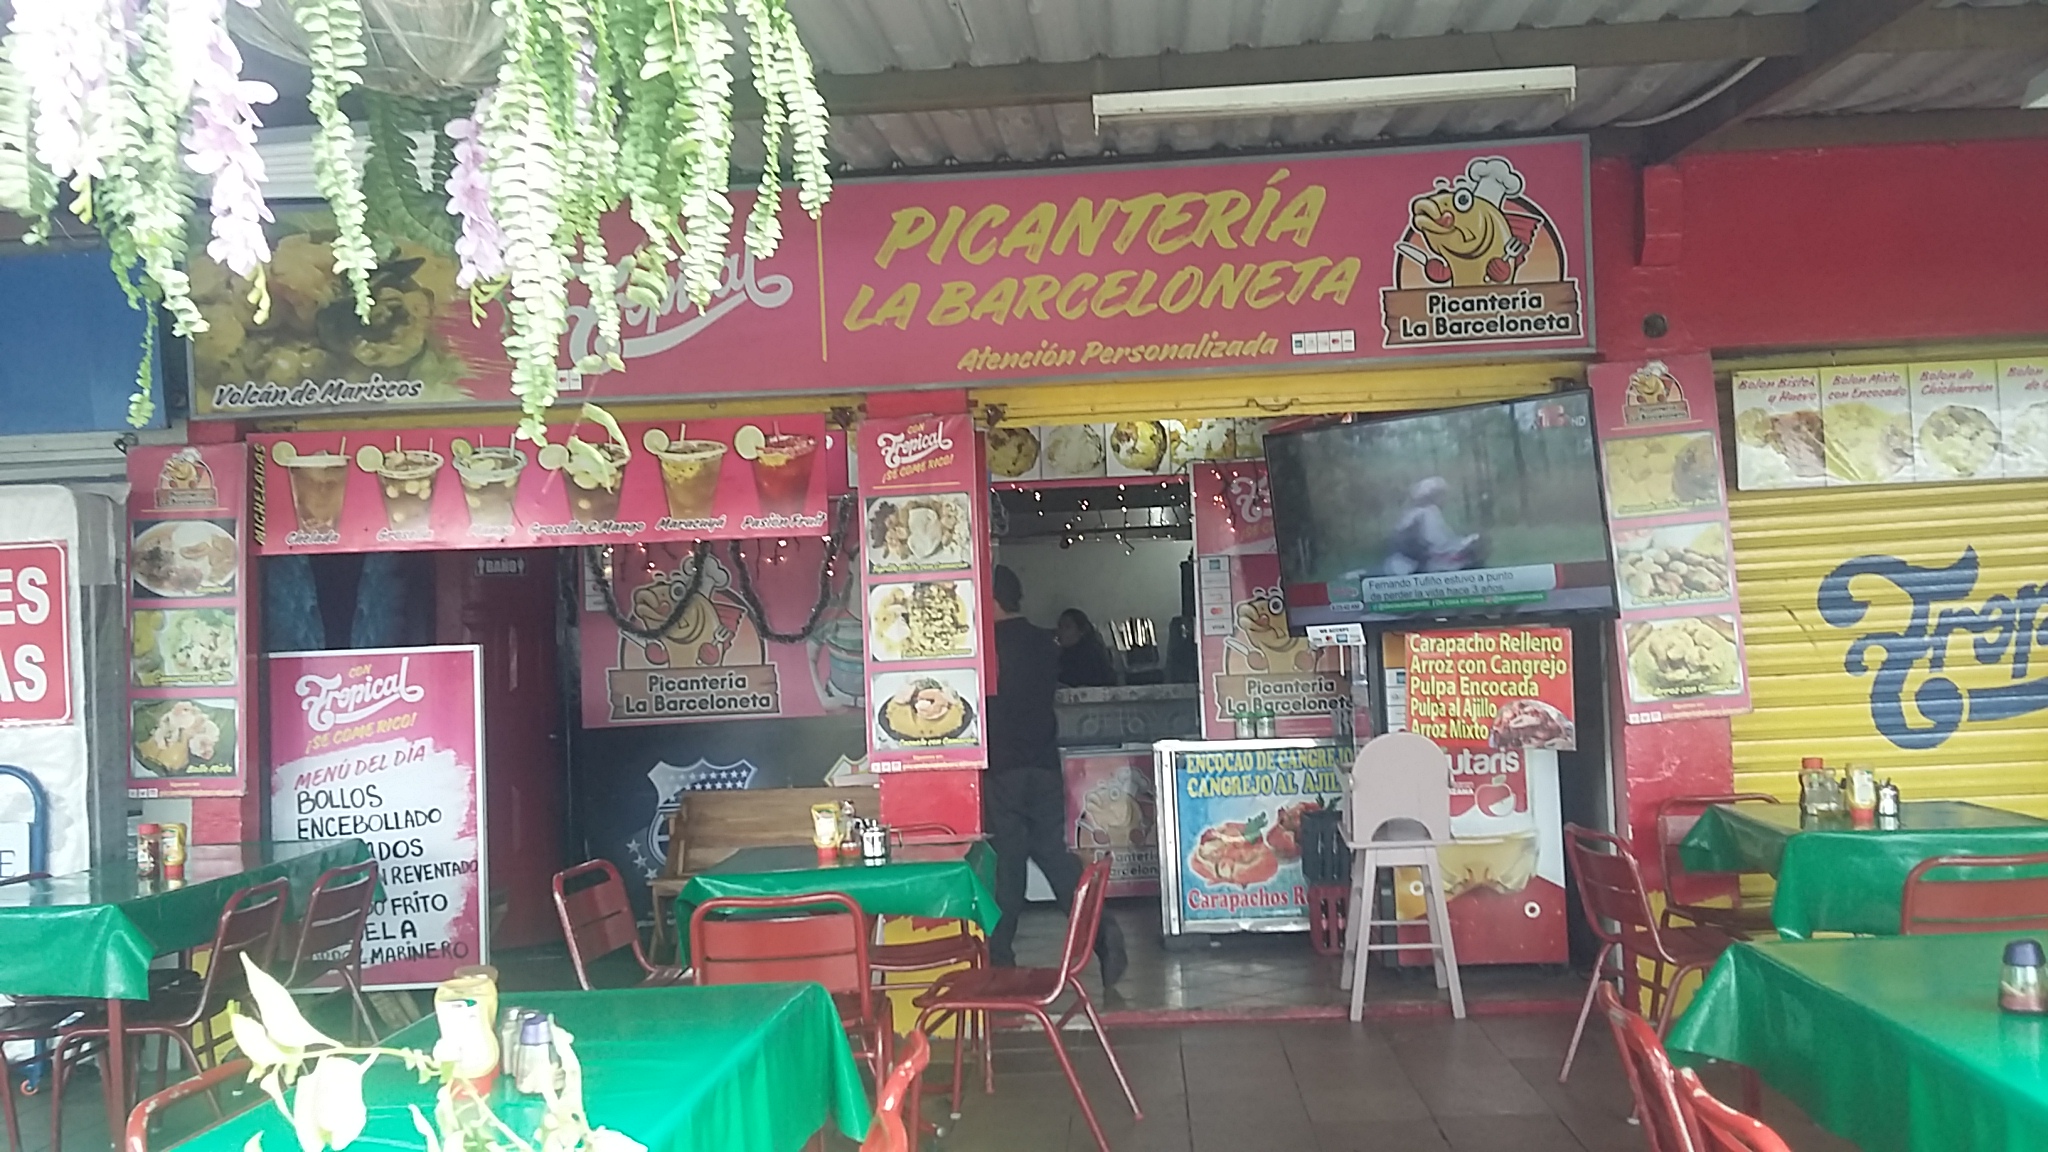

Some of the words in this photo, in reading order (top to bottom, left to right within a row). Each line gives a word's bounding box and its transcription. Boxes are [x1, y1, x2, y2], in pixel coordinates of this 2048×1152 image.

[874, 168, 1326, 269] PICANTERÍA
[843, 282, 921, 331] LA
[927, 256, 1361, 326] BARCELONETA
[1429, 291, 1542, 313] Picantería
[1402, 318, 1427, 337] La
[1435, 315, 1570, 335] Barceloneta
[957, 339, 1076, 373] Atención
[1080, 331, 1279, 365] Personalizada
[214, 382, 287, 406] Volcán
[291, 380, 319, 405] de
[321, 374, 423, 403] Mariscos
[877, 420, 954, 469] Tropical
[254, 443, 266, 546] MICHELADAS
[789, 510, 828, 529] Fruit
[1369, 579, 1411, 590] Fernando
[1445, 575, 1475, 585] estuvo
[1486, 571, 1514, 582] punto
[1426, 586, 1445, 597] vida
[1410, 632, 1496, 657] Carapacho
[1500, 631, 1563, 653] Relleno
[1410, 654, 1454, 675] Arroz
[1457, 658, 1487, 675] con
[1490, 654, 1568, 680] Cangrejo
[295, 656, 425, 732] Tropical
[649, 672, 747, 693] Picantería
[1247, 676, 1336, 695] Picantería
[1410, 676, 1457, 700] Pulpa
[1460, 676, 1540, 697] Encocada
[626, 695, 648, 713] La
[654, 693, 771, 712] Barceloneta
[1227, 698, 1247, 714] La
[1410, 697, 1447, 721] Pulpa
[1448, 697, 1461, 717] al
[1463, 696, 1498, 722] Ajillo
[333, 722, 375, 744] COME
[377, 712, 418, 734] RICO!
[1411, 718, 1448, 739] Arroz
[1450, 718, 1490, 740] Mixto
[294, 759, 352, 790] MENÚ
[355, 754, 389, 776] DEL
[394, 742, 427, 767] DÍA
[1186, 750, 1255, 774] ENCOCAO
[1256, 749, 1277, 771] DE
[1277, 747, 1355, 769] CANGREJO
[1444, 746, 1520, 775] utaris
[1187, 775, 1273, 799] CANGREJO
[1275, 772, 1299, 795] AL
[1303, 772, 1343, 795] AJIL
[297, 784, 383, 815] BOLLOS
[297, 808, 443, 840] ENCEBOLLADO
[391, 860, 479, 886] REVENTADO
[391, 890, 449, 917] FRITO
[1187, 887, 1289, 913] Carapachos
[371, 940, 469, 965] MARINERO
